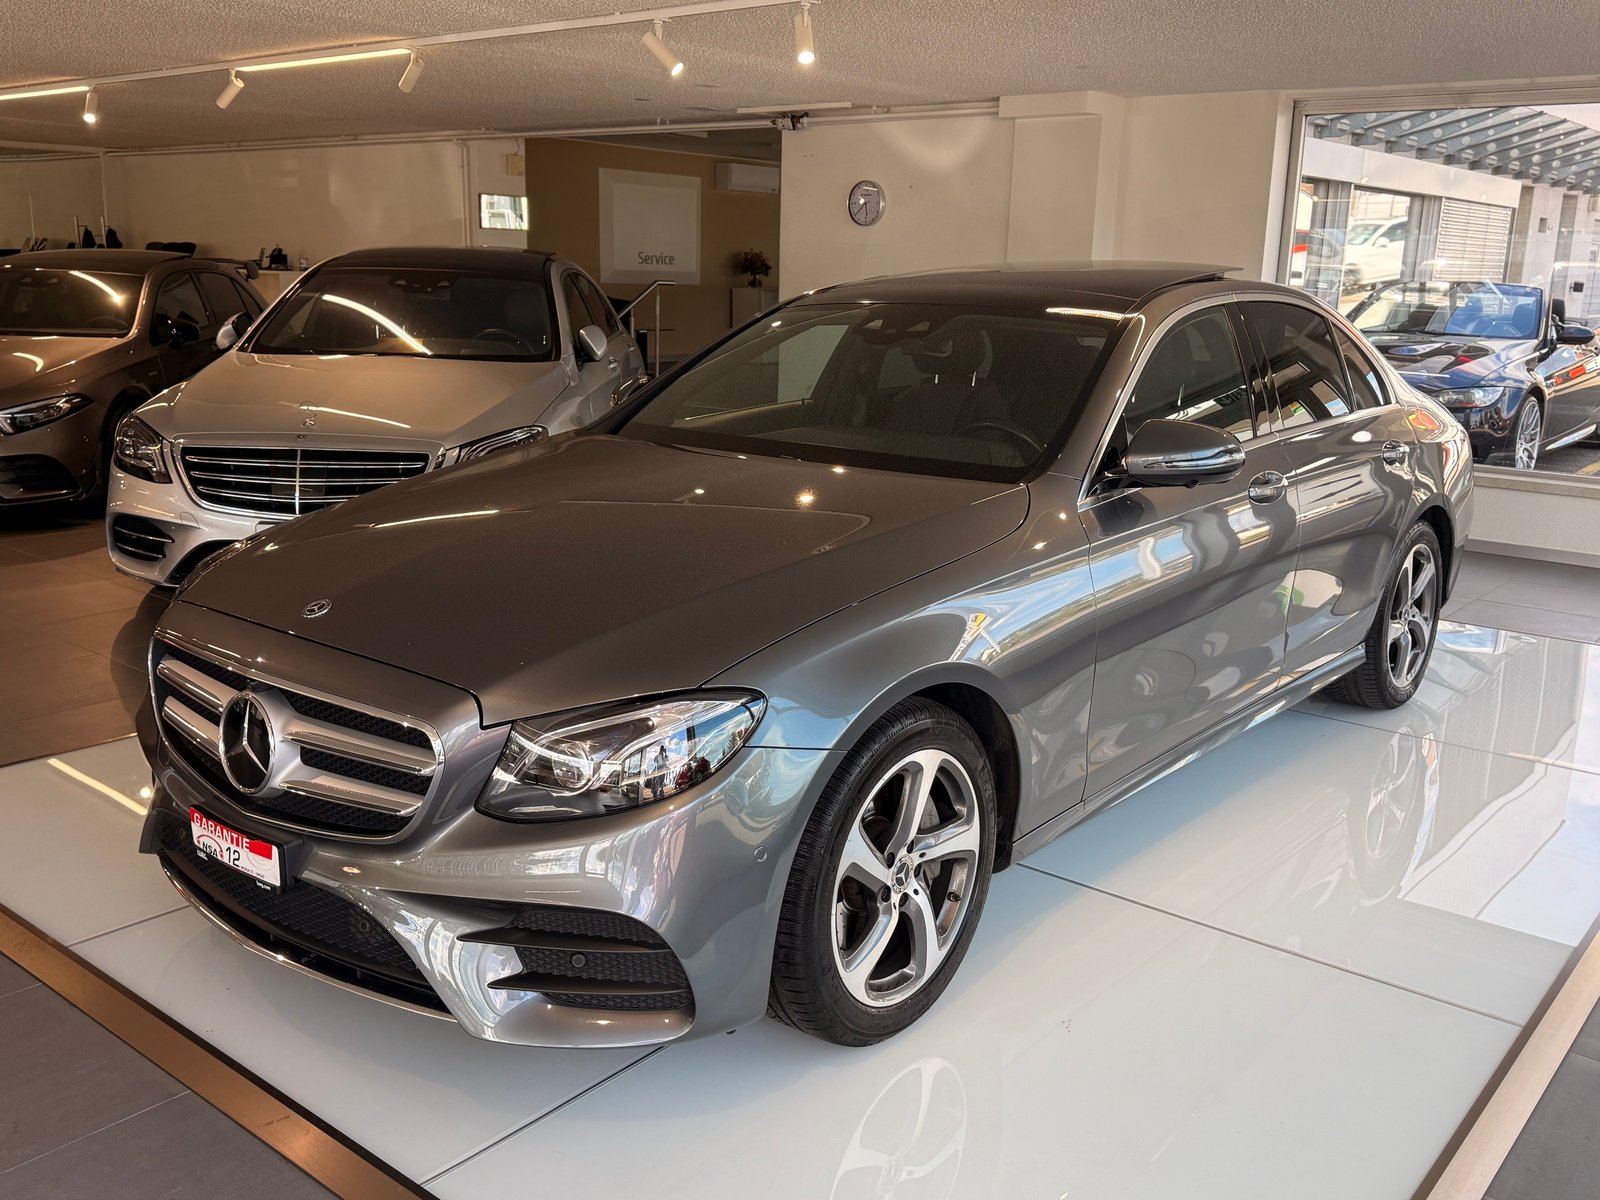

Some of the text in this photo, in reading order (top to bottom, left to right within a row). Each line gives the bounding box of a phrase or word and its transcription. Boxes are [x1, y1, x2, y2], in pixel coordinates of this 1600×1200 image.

[638, 251, 675, 265] Service
[194, 812, 250, 852] GARANTIE
[202, 841, 219, 858] NSA
[225, 846, 241, 868] 12
